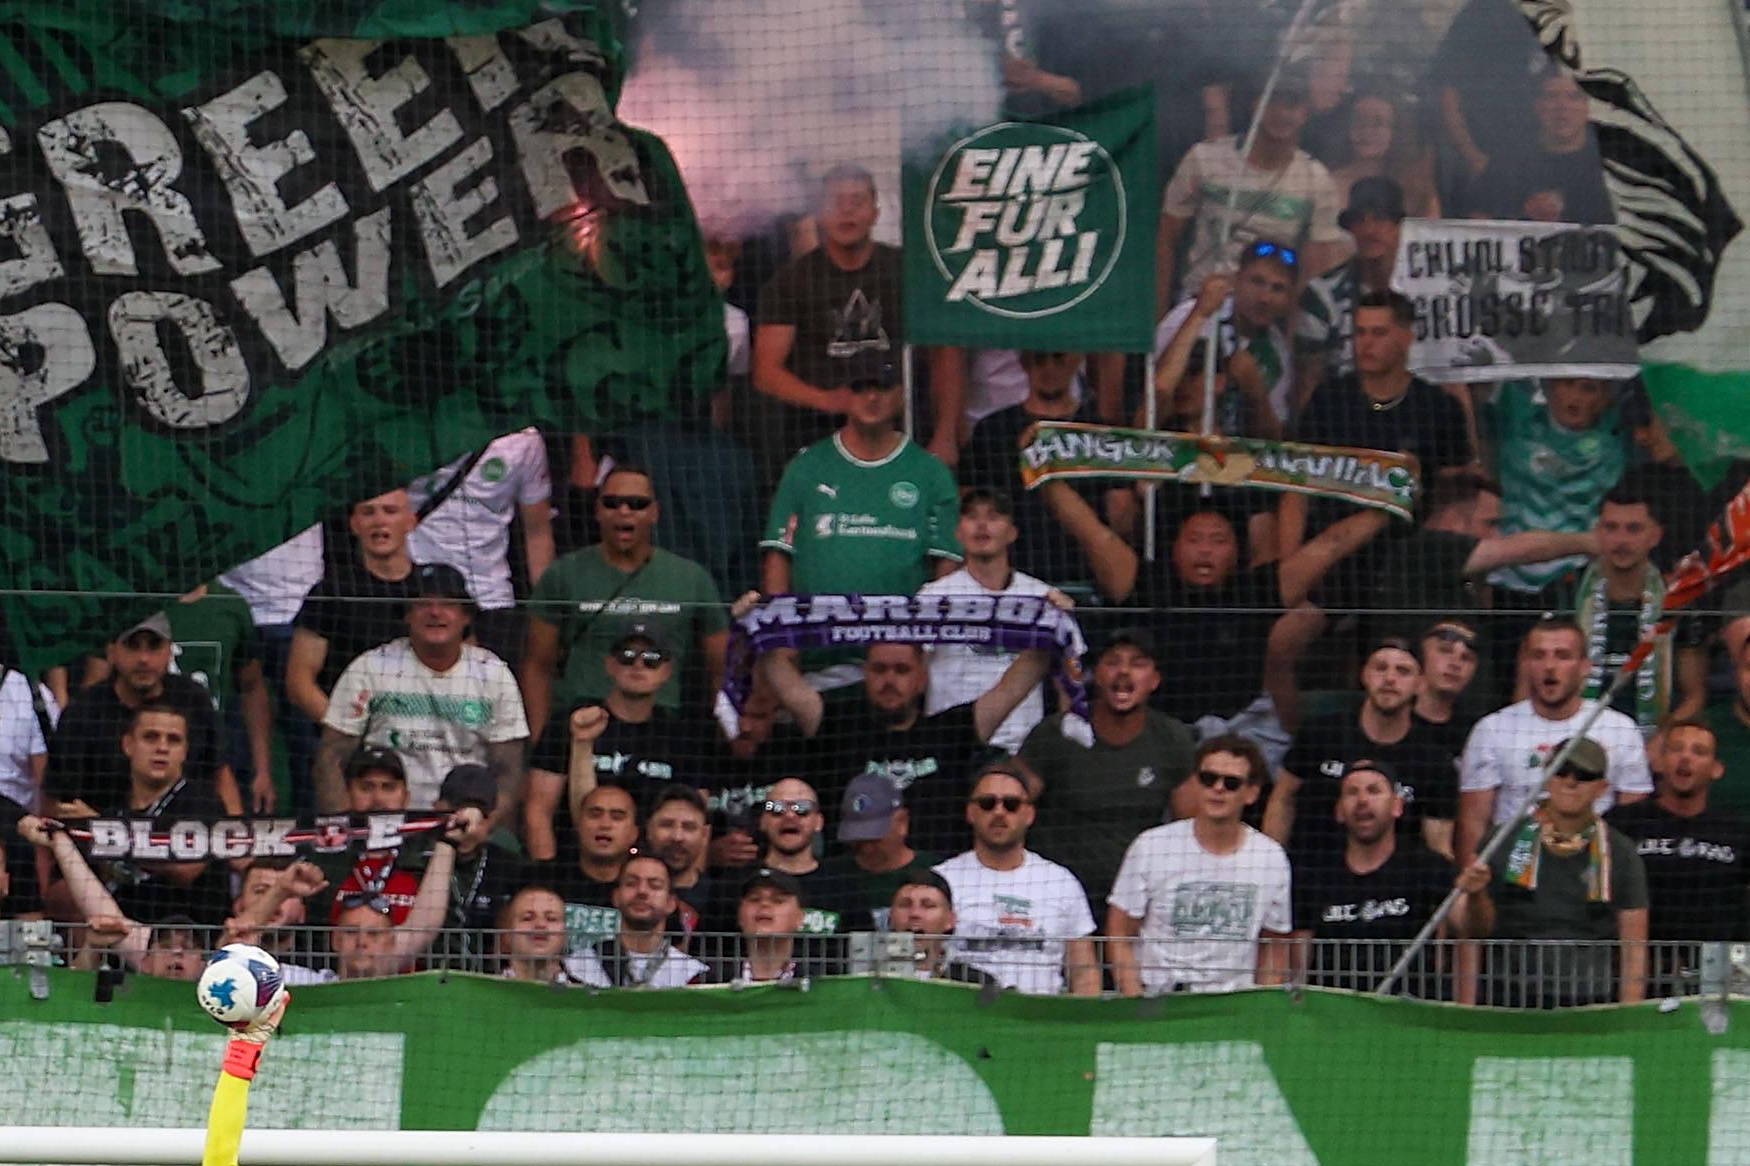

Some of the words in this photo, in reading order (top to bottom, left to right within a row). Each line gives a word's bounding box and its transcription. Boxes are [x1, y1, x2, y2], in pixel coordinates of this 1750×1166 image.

[940, 142, 1098, 199] EINE
[944, 191, 1086, 253] FÜR
[945, 229, 1098, 302] ALLI
[832, 624, 937, 641] FOOTBALL
[89, 818, 298, 860] BLOCK
[365, 813, 406, 851] E
